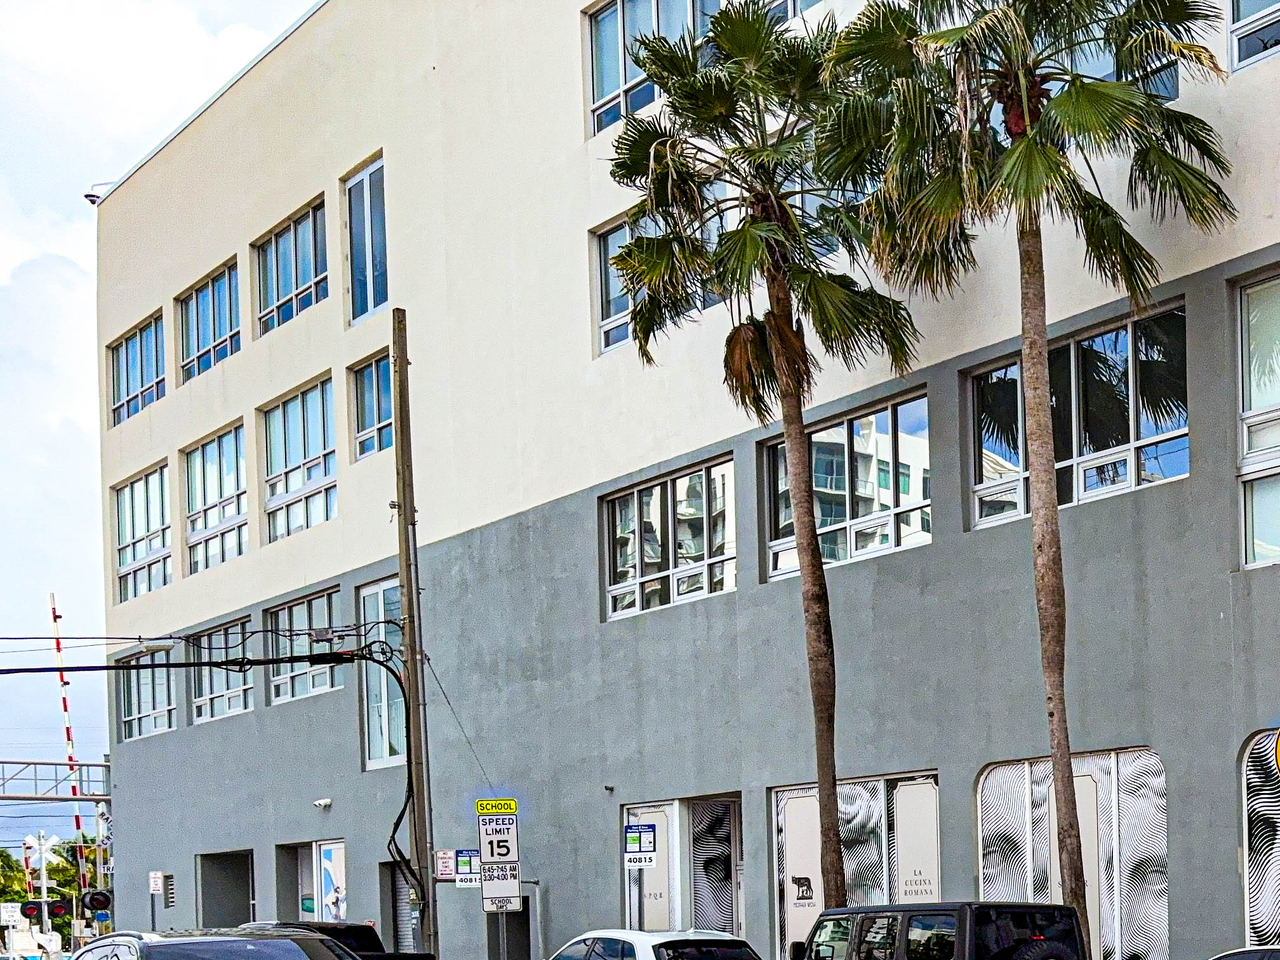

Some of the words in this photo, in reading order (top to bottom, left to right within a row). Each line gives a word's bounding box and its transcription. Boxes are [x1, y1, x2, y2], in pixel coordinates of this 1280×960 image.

[479, 802, 514, 810] SCHOOL
[481, 818, 514, 826] SPEED
[485, 827, 511, 836] LIMIT
[488, 839, 511, 857] 15
[627, 856, 653, 864] 40815
